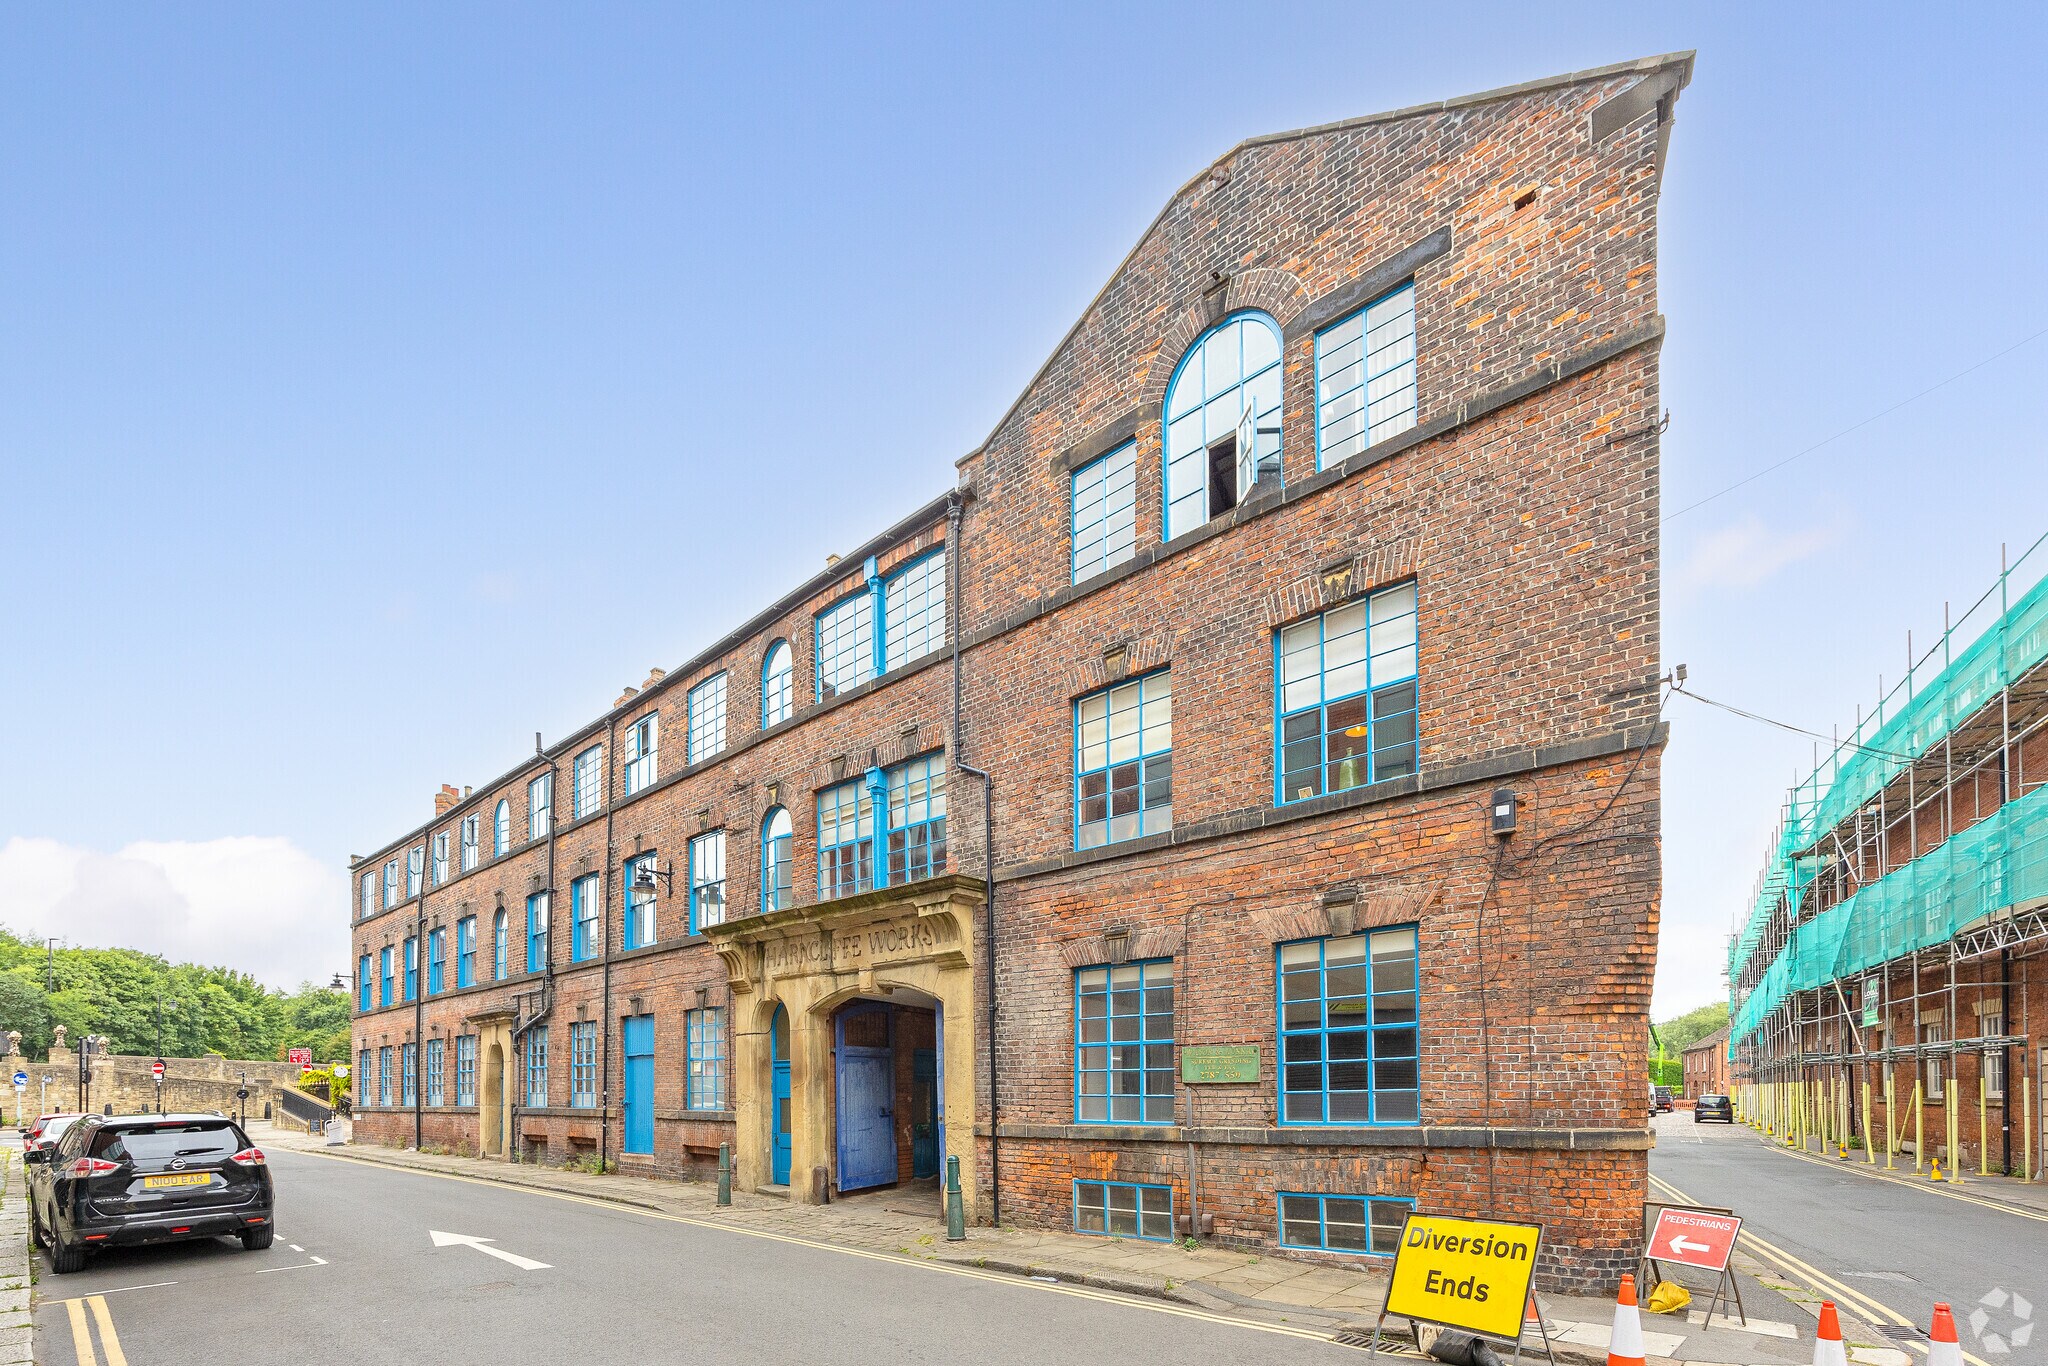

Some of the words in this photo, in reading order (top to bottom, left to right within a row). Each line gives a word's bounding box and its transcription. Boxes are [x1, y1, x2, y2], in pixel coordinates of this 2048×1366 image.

[755, 934, 861, 969] HARNCLFFE
[867, 924, 932, 954] WORKS
[1200, 1071, 1220, 1079] 2787
[152, 1176, 178, 1186] N100
[181, 1175, 204, 1184] EAR
[1664, 1214, 1732, 1231] PEDESTRIANS
[1407, 1226, 1528, 1261] Diversion
[1424, 1269, 1490, 1302] Ends
